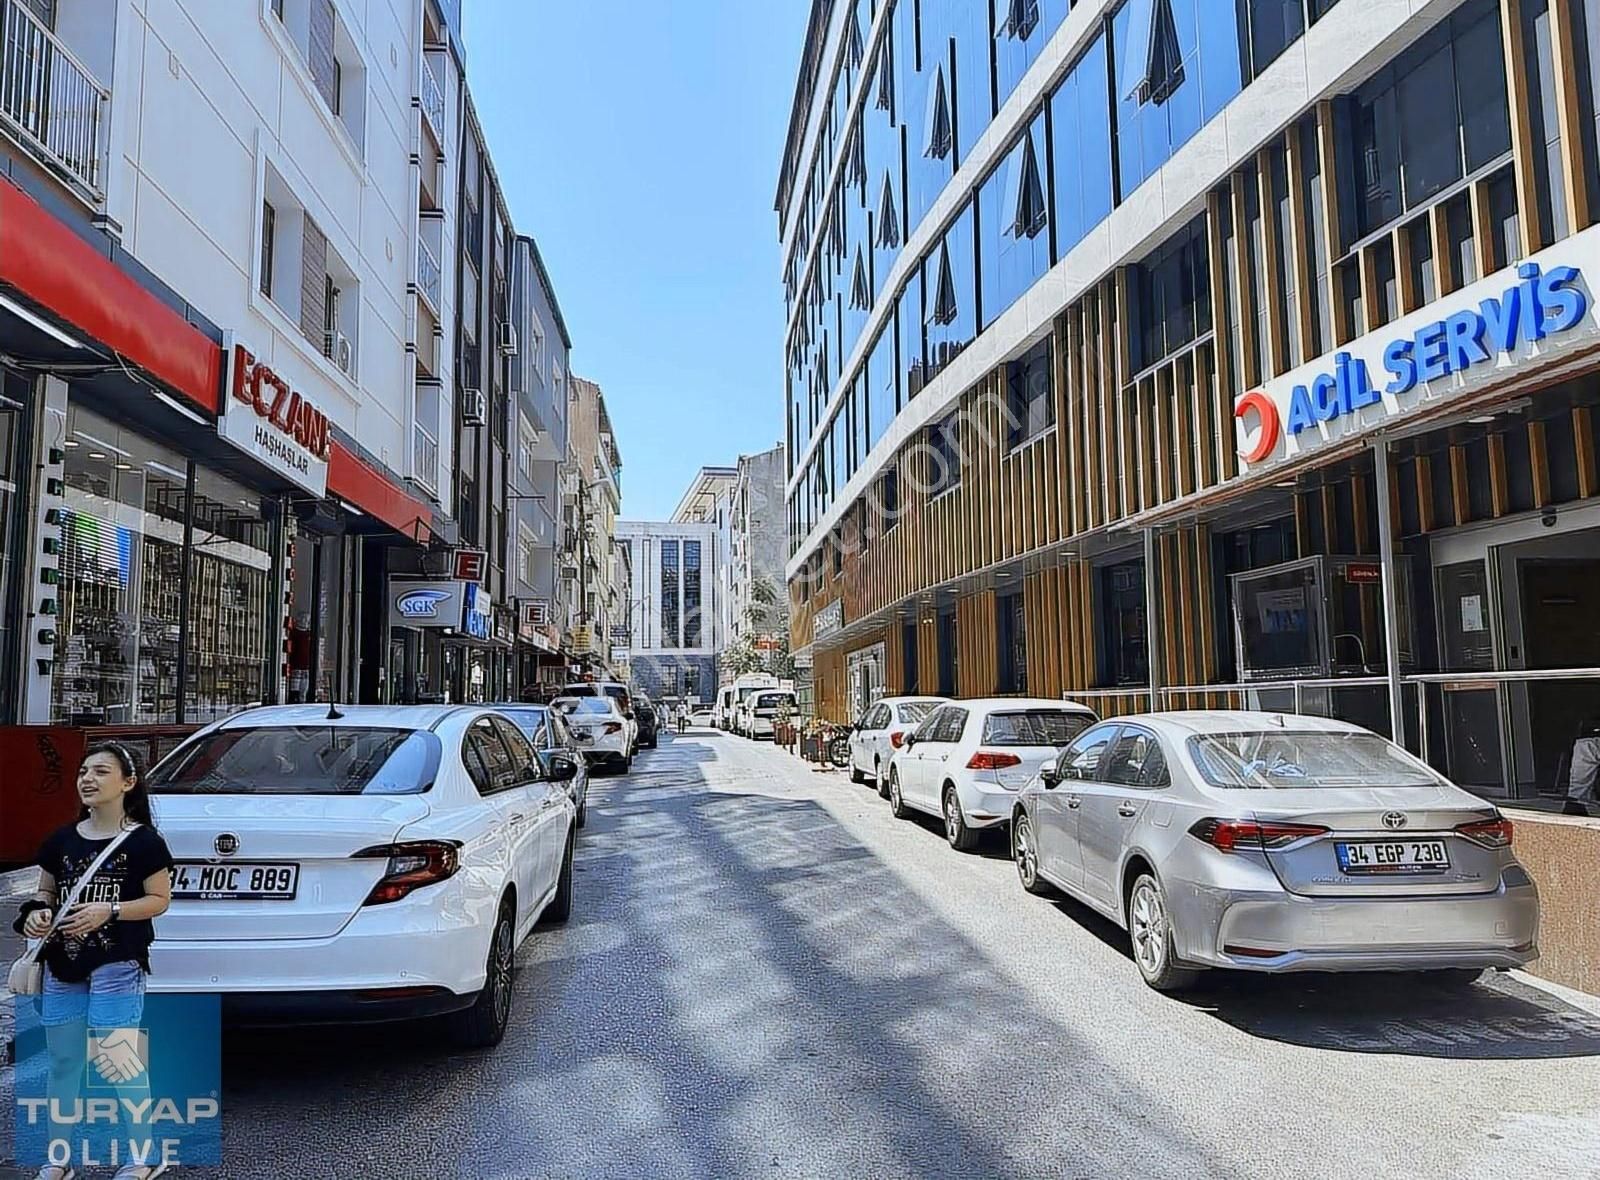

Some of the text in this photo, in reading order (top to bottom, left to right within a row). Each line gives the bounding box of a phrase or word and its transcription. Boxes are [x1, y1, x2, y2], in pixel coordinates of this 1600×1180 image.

[1287, 262, 1587, 436] ACİL SERVİS
[254, 424, 309, 476] HAŞHAŞLAR
[404, 601, 436, 613] SGK
[1348, 846, 1370, 865] 34
[1375, 846, 1405, 863] EGP
[199, 867, 241, 891] MOC
[250, 868, 291, 891] 889
